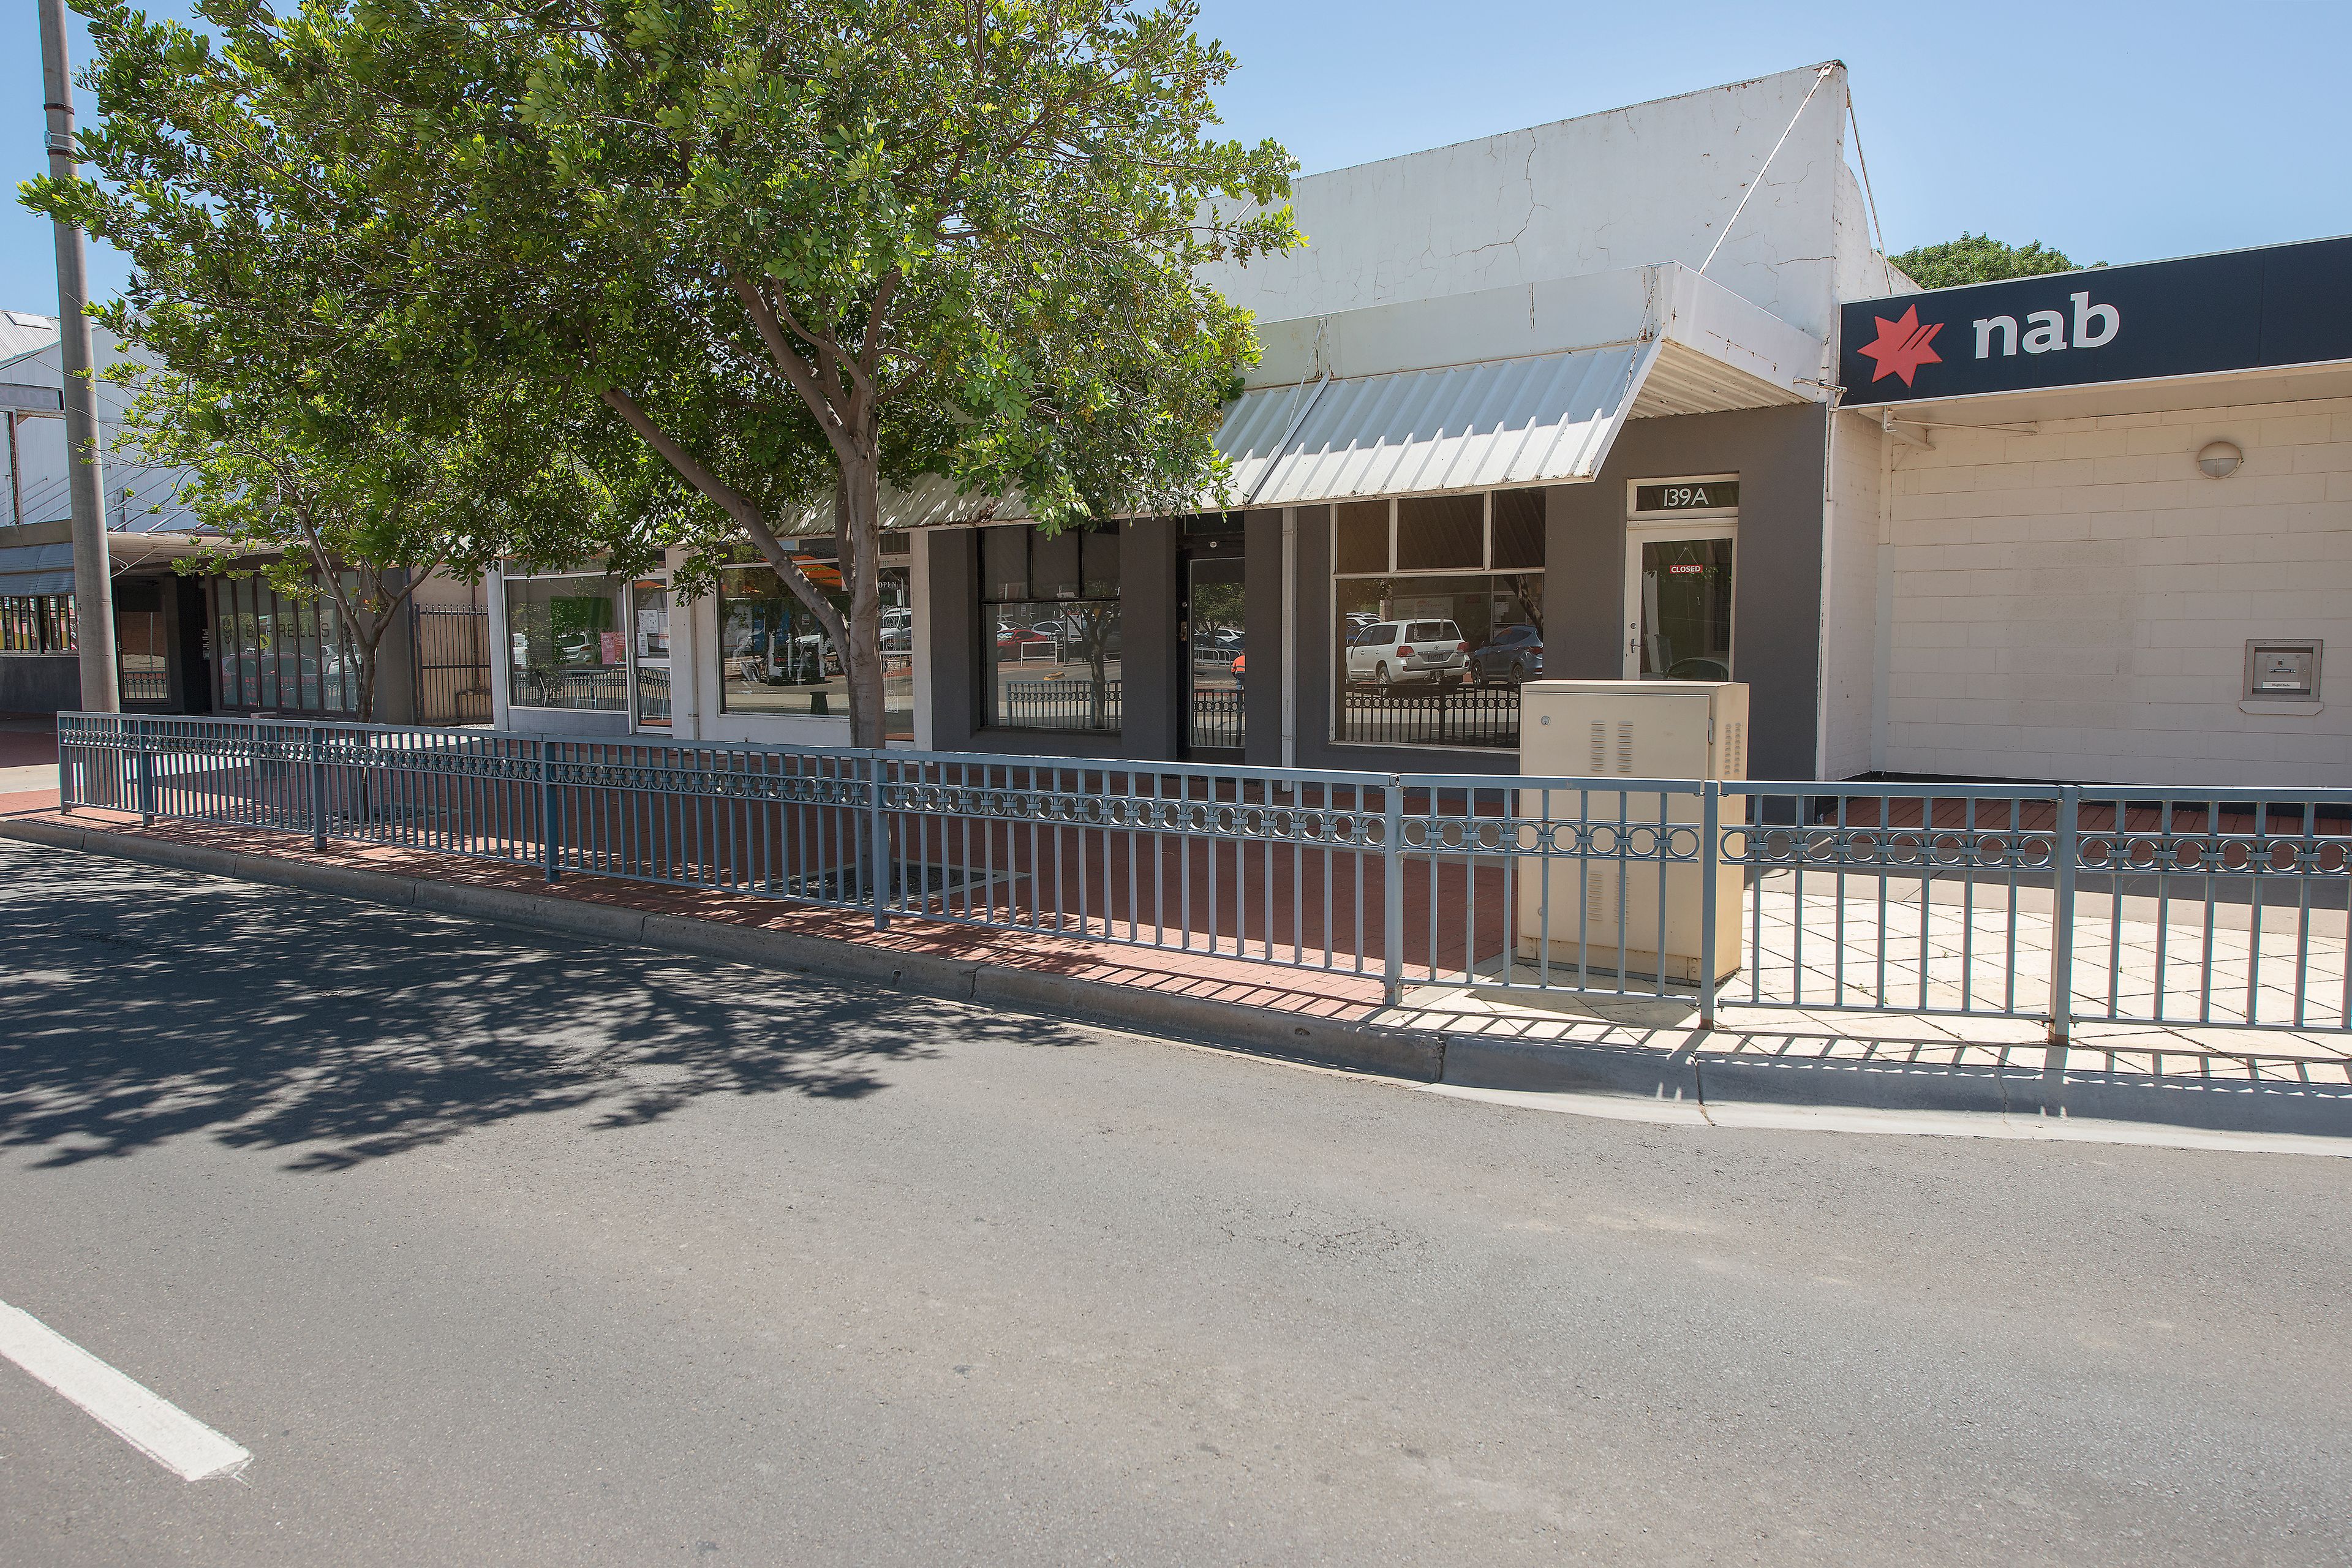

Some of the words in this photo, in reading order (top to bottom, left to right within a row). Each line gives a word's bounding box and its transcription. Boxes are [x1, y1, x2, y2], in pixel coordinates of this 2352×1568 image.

[1973, 291, 2120, 359] nab
[1664, 488, 1709, 507] 139A
[246, 622, 330, 638] BRRELLS
